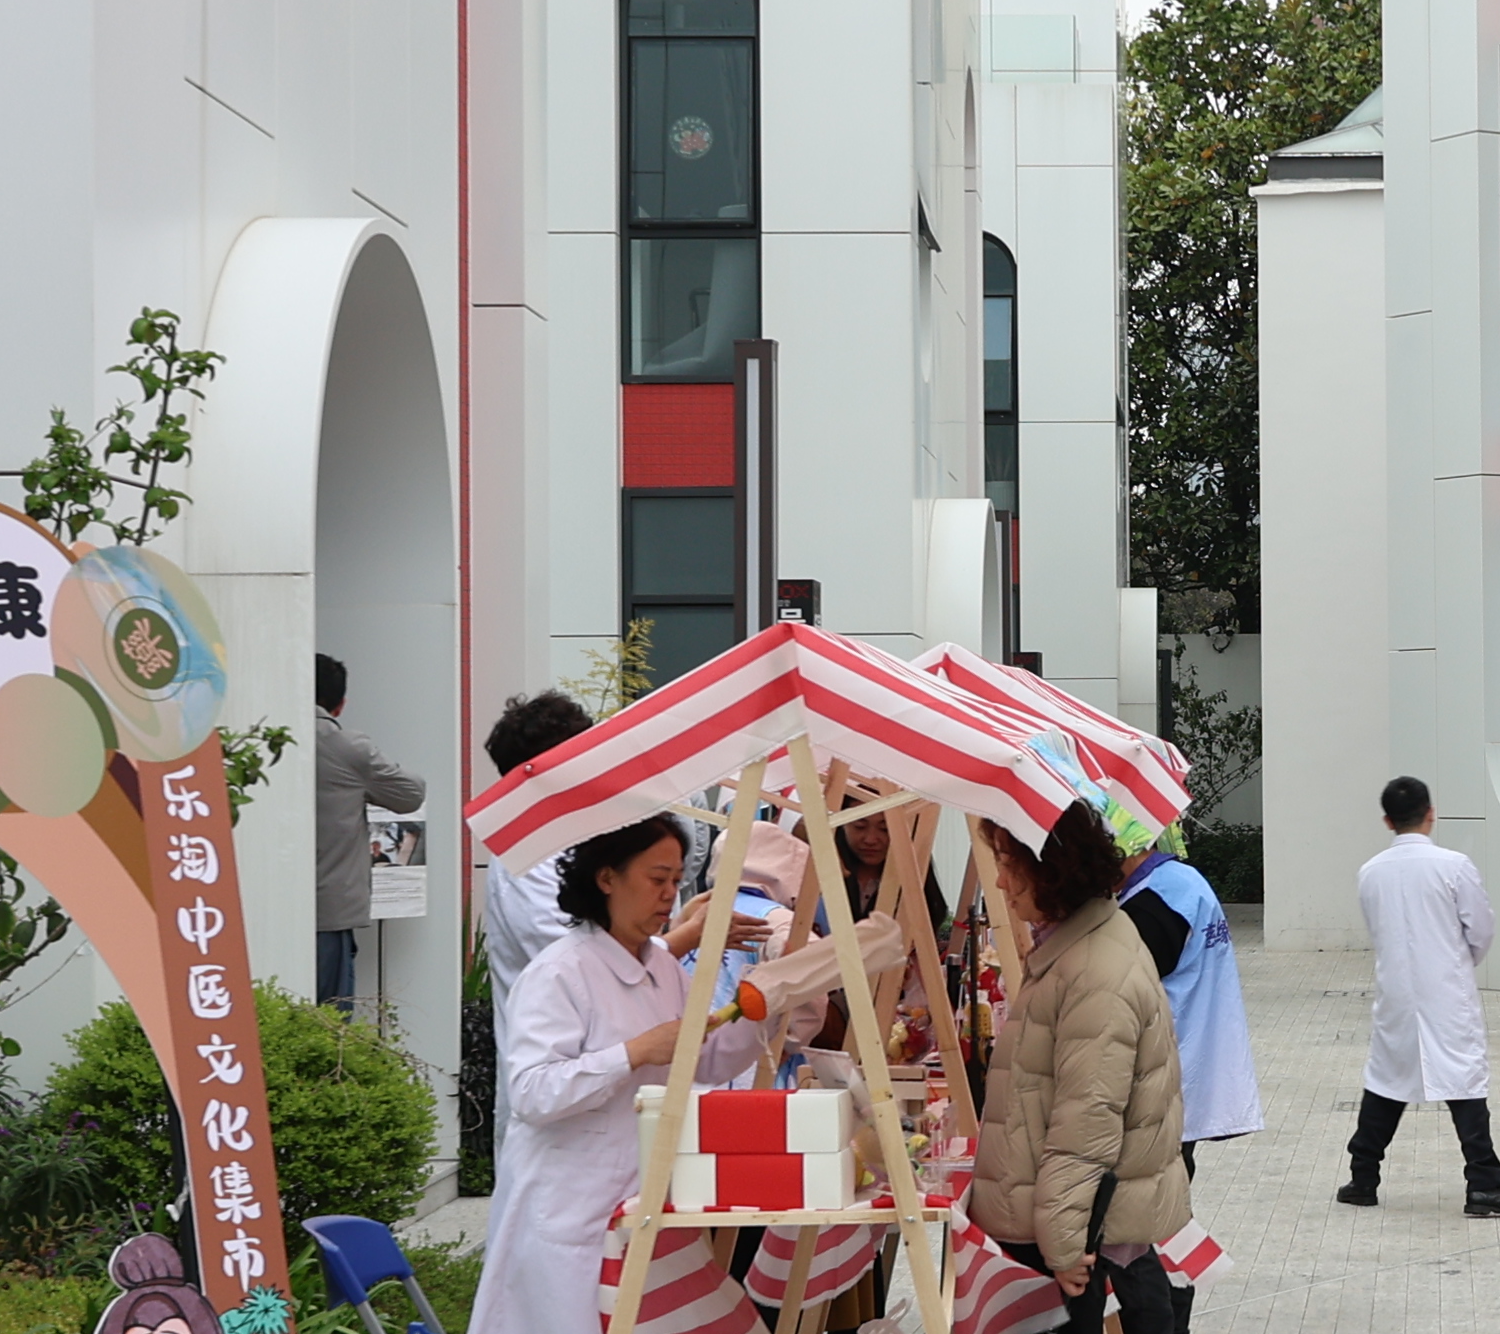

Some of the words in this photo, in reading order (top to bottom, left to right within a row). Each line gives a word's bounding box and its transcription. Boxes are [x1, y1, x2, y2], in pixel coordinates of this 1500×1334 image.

[159, 765, 266, 1285] 乐淘中医文化集市
